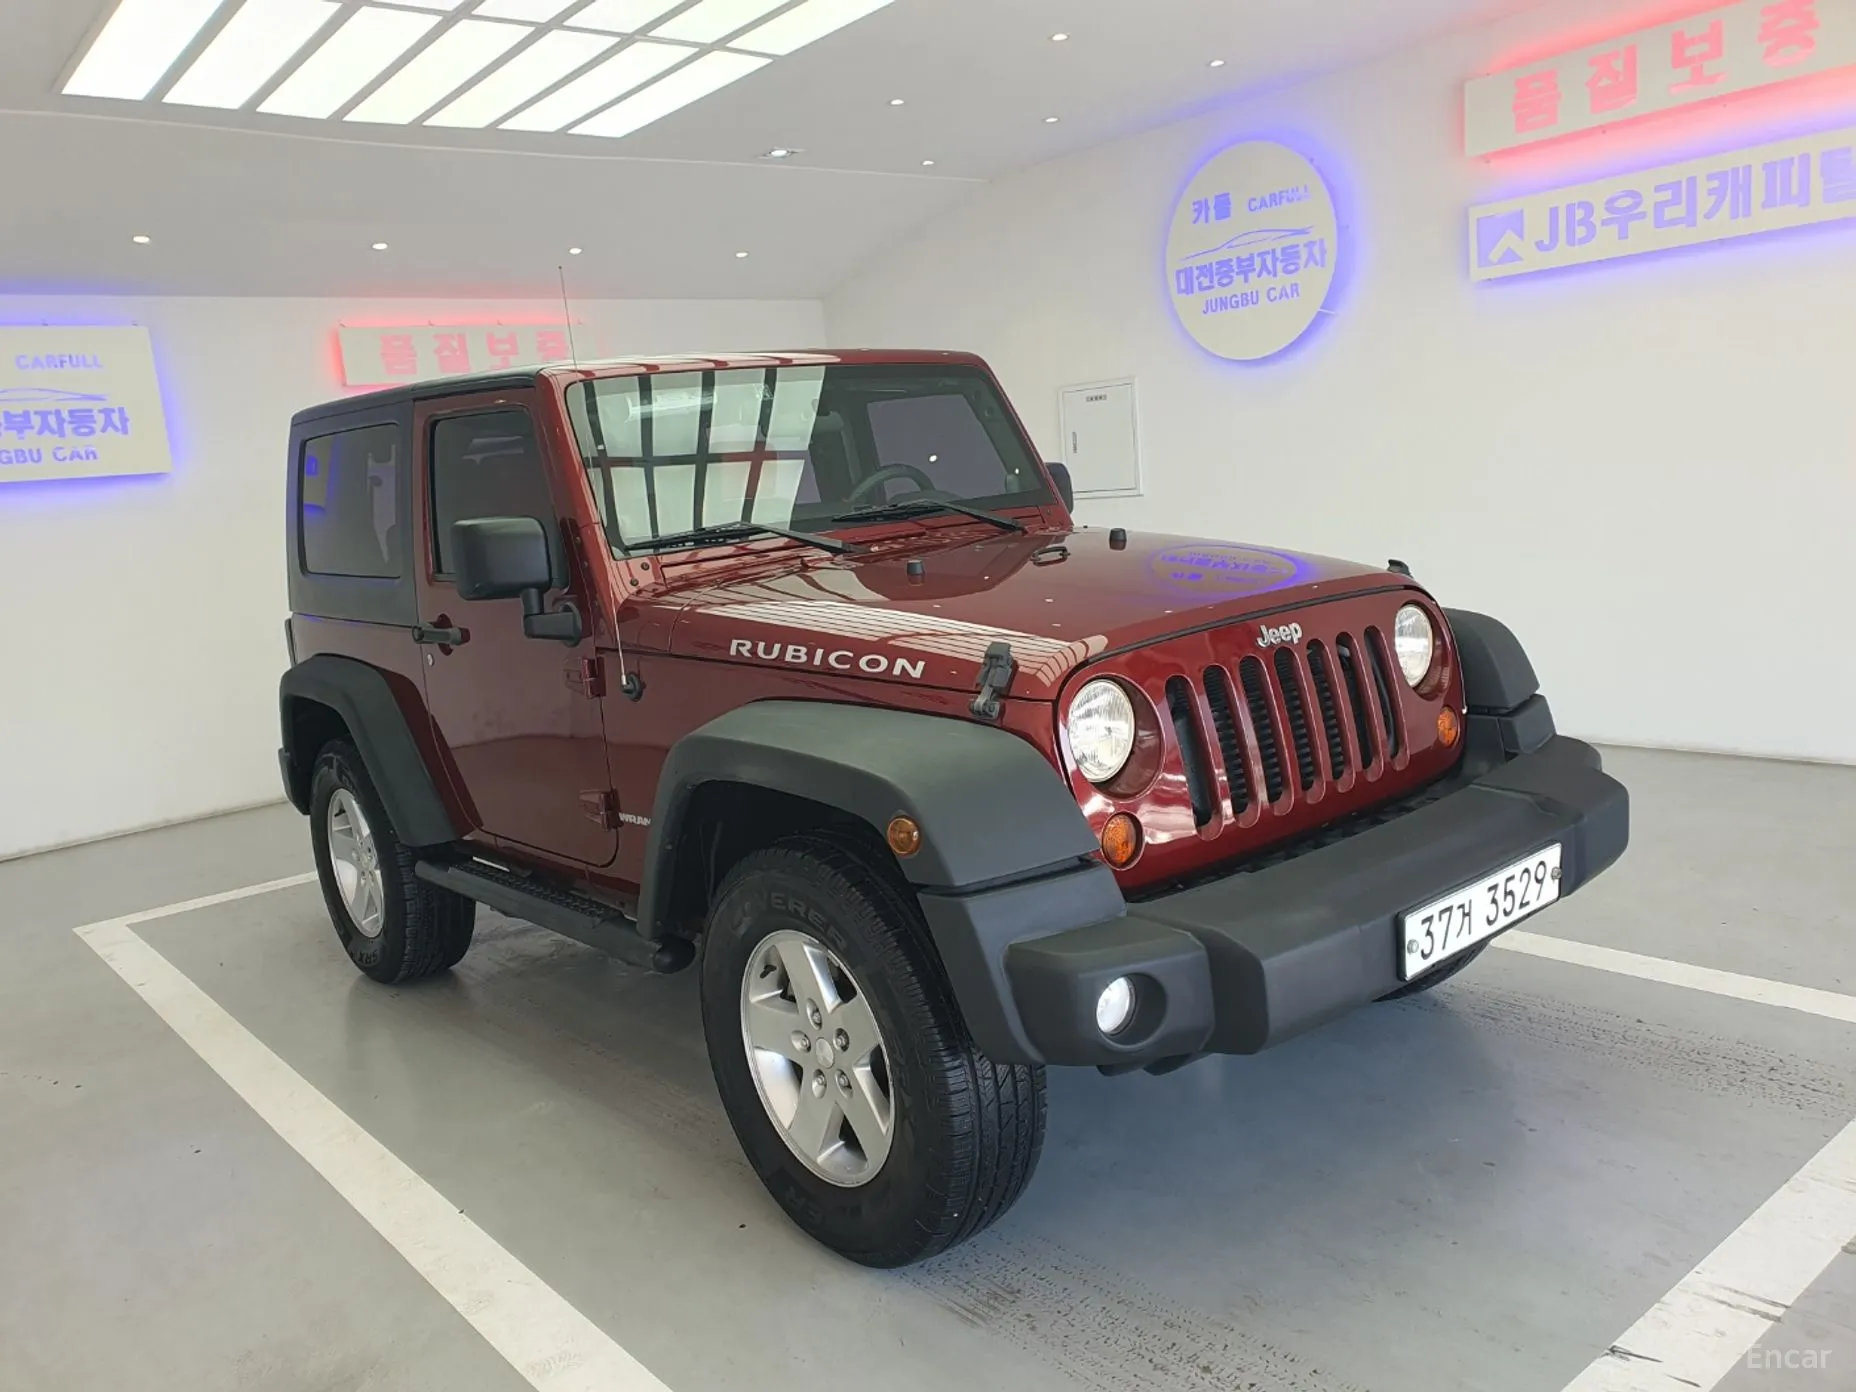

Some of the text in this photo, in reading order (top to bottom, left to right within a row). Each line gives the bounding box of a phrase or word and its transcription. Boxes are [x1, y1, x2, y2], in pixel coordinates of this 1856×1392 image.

[1202, 283, 1300, 314] JUNGBU CAR
[15, 354, 103, 370] CARFULL
[52, 446, 98, 461] CAR
[1257, 622, 1303, 648] Jeep
[729, 638, 926, 679] RUBICON
[1486, 860, 1547, 927] 3529
